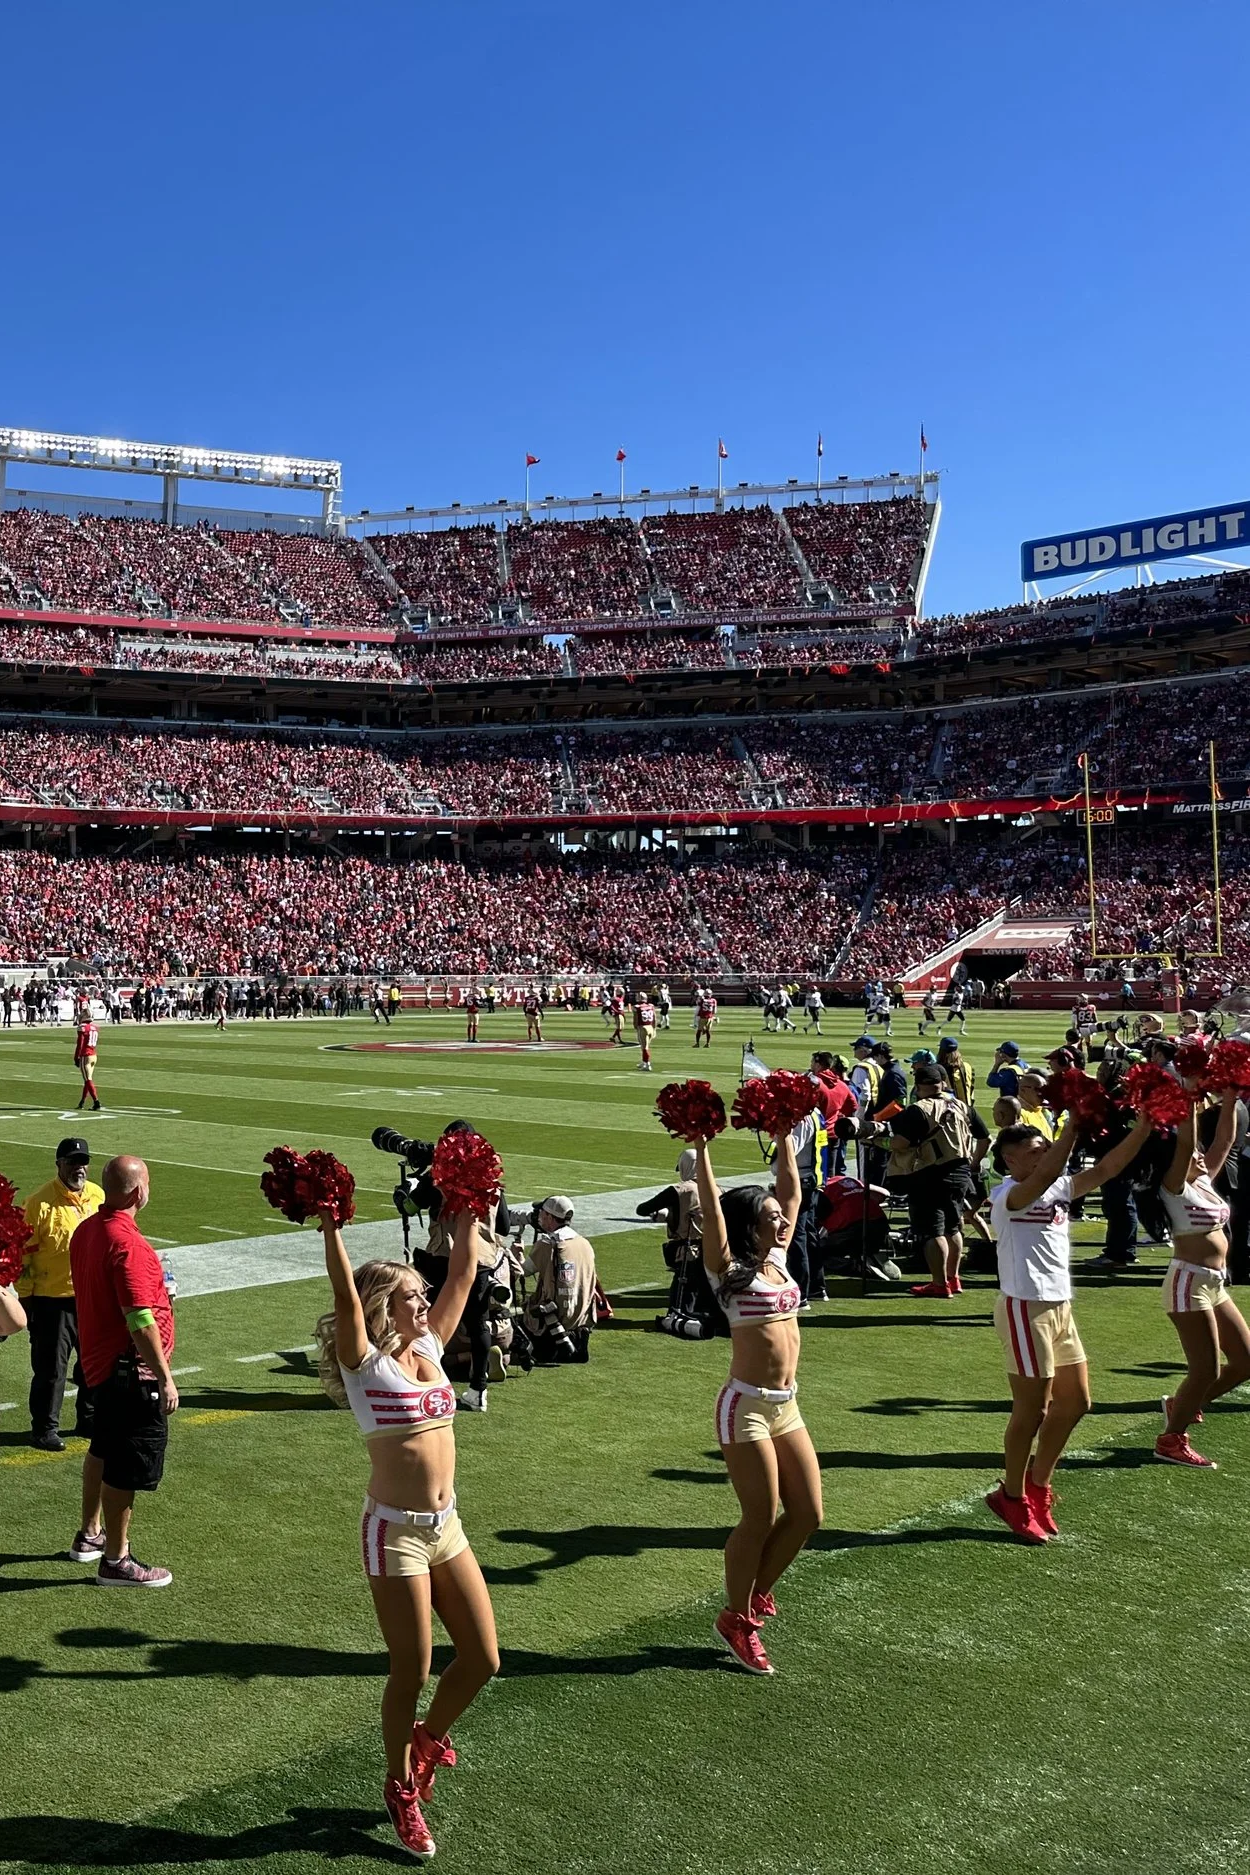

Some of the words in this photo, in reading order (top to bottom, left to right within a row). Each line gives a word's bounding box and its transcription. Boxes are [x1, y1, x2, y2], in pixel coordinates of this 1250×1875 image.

[488, 629, 508, 637] NEED
[561, 624, 580, 633] TEXT
[721, 614, 755, 624] INCLUDE
[835, 609, 852, 618] AND
[1078, 1010, 1093, 1022] 83
[88, 1029, 98, 1047] 10
